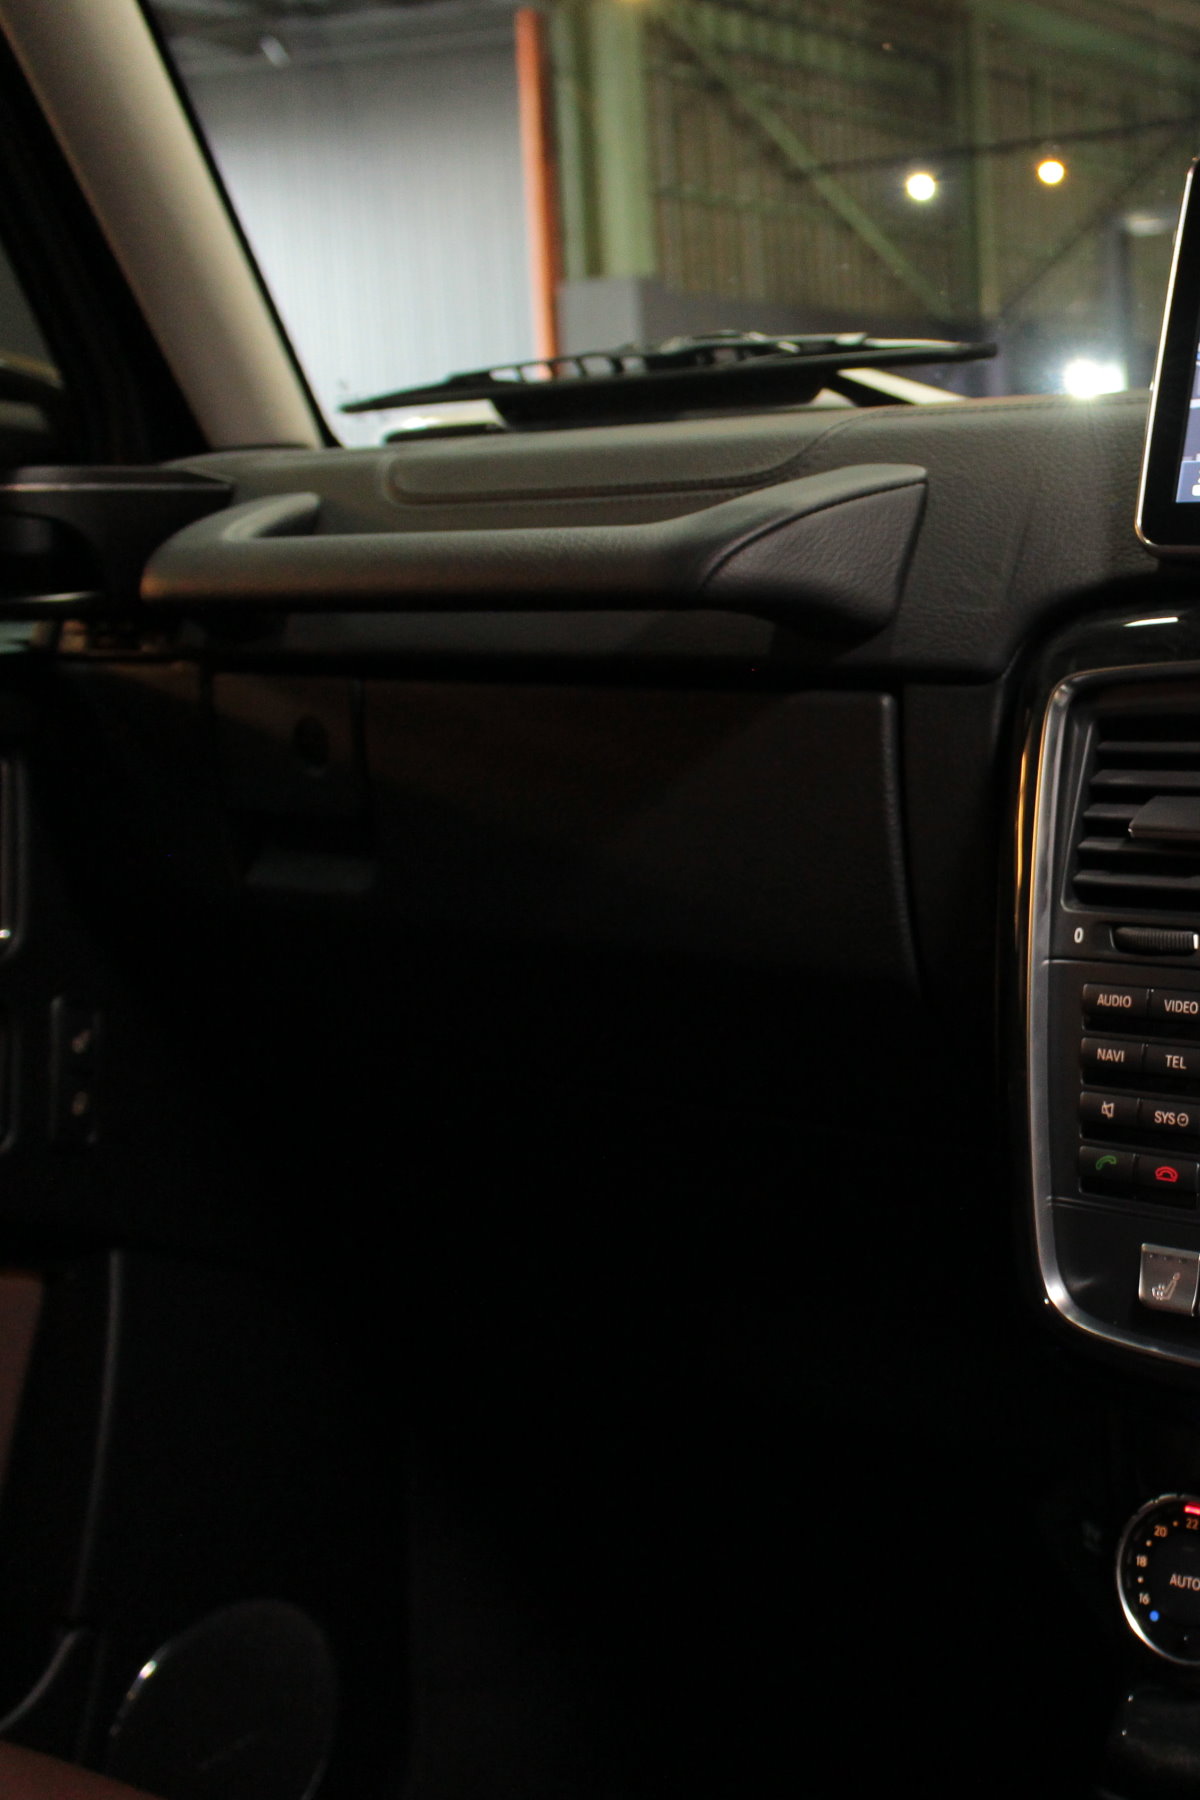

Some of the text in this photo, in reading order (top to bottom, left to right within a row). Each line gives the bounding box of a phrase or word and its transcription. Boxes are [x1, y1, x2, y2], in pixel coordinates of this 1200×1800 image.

[1096, 994, 1132, 1009] AUDIO
[1163, 999, 1199, 1015] VIDEO
[1096, 1048, 1125, 1063] NAVI
[1165, 1055, 1187, 1070] TEL
[1154, 1110, 1176, 1126] SYS
[1185, 1518, 1199, 1530] 22
[1154, 1526, 1168, 1538] 20
[1136, 1555, 1147, 1567] 18
[1139, 1593, 1150, 1605] 16
